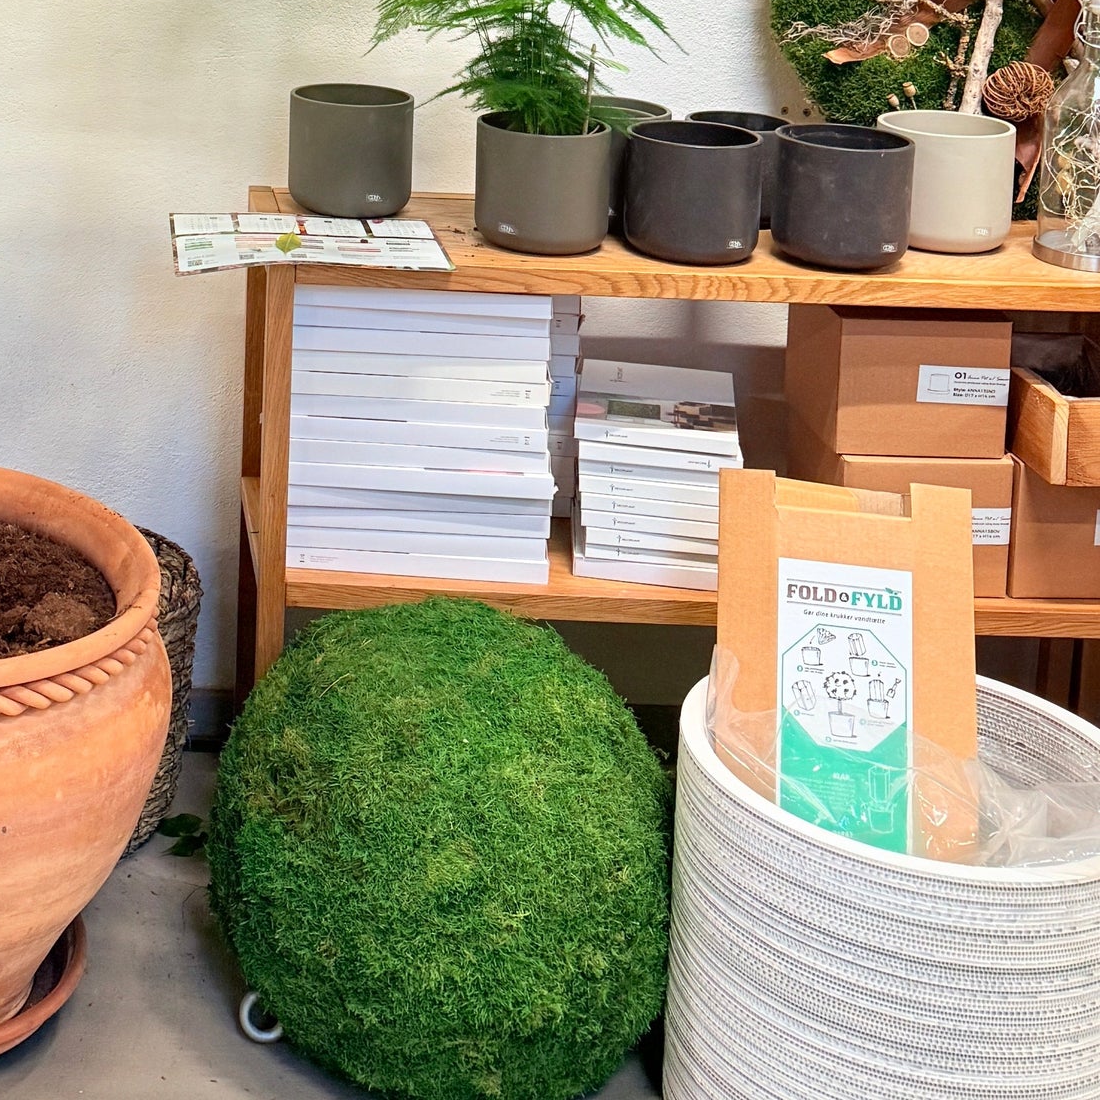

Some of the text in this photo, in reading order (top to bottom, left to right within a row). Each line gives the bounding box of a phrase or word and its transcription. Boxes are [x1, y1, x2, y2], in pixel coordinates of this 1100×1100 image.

[786, 583, 903, 611] FOLD & FYLD
[815, 610, 829, 618] dine
[830, 611, 853, 620] krukker
